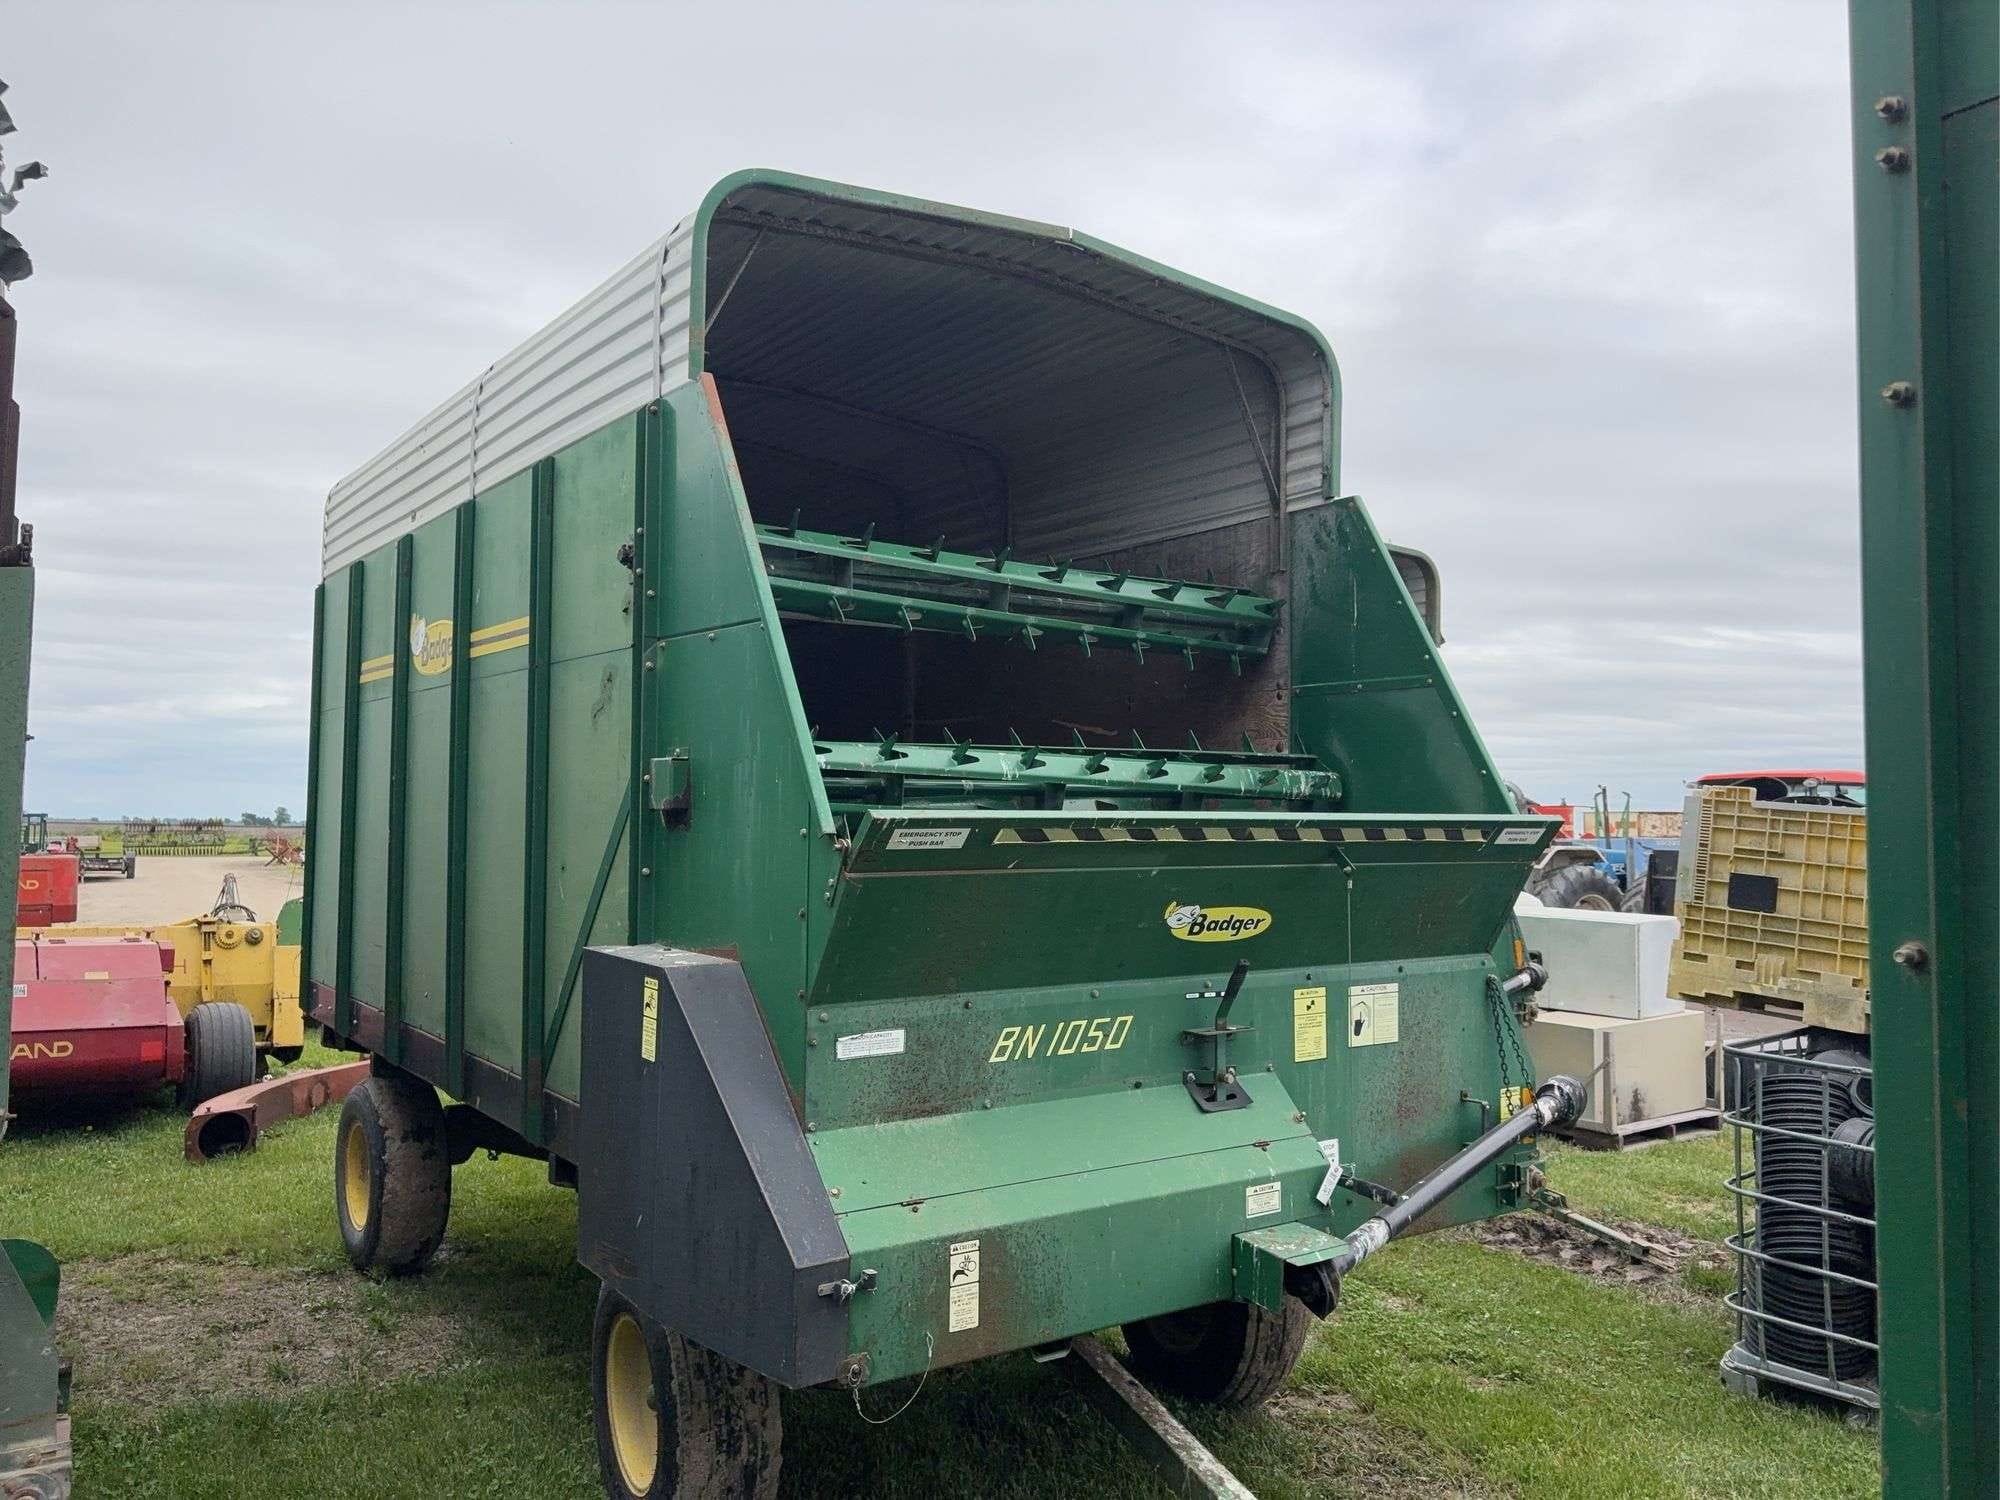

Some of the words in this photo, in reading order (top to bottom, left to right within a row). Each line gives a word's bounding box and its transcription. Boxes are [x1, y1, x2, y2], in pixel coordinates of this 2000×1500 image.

[1187, 913, 1267, 937] Badger
[988, 1023, 1046, 1063] BN
[1046, 1015, 1134, 1057] 1050
